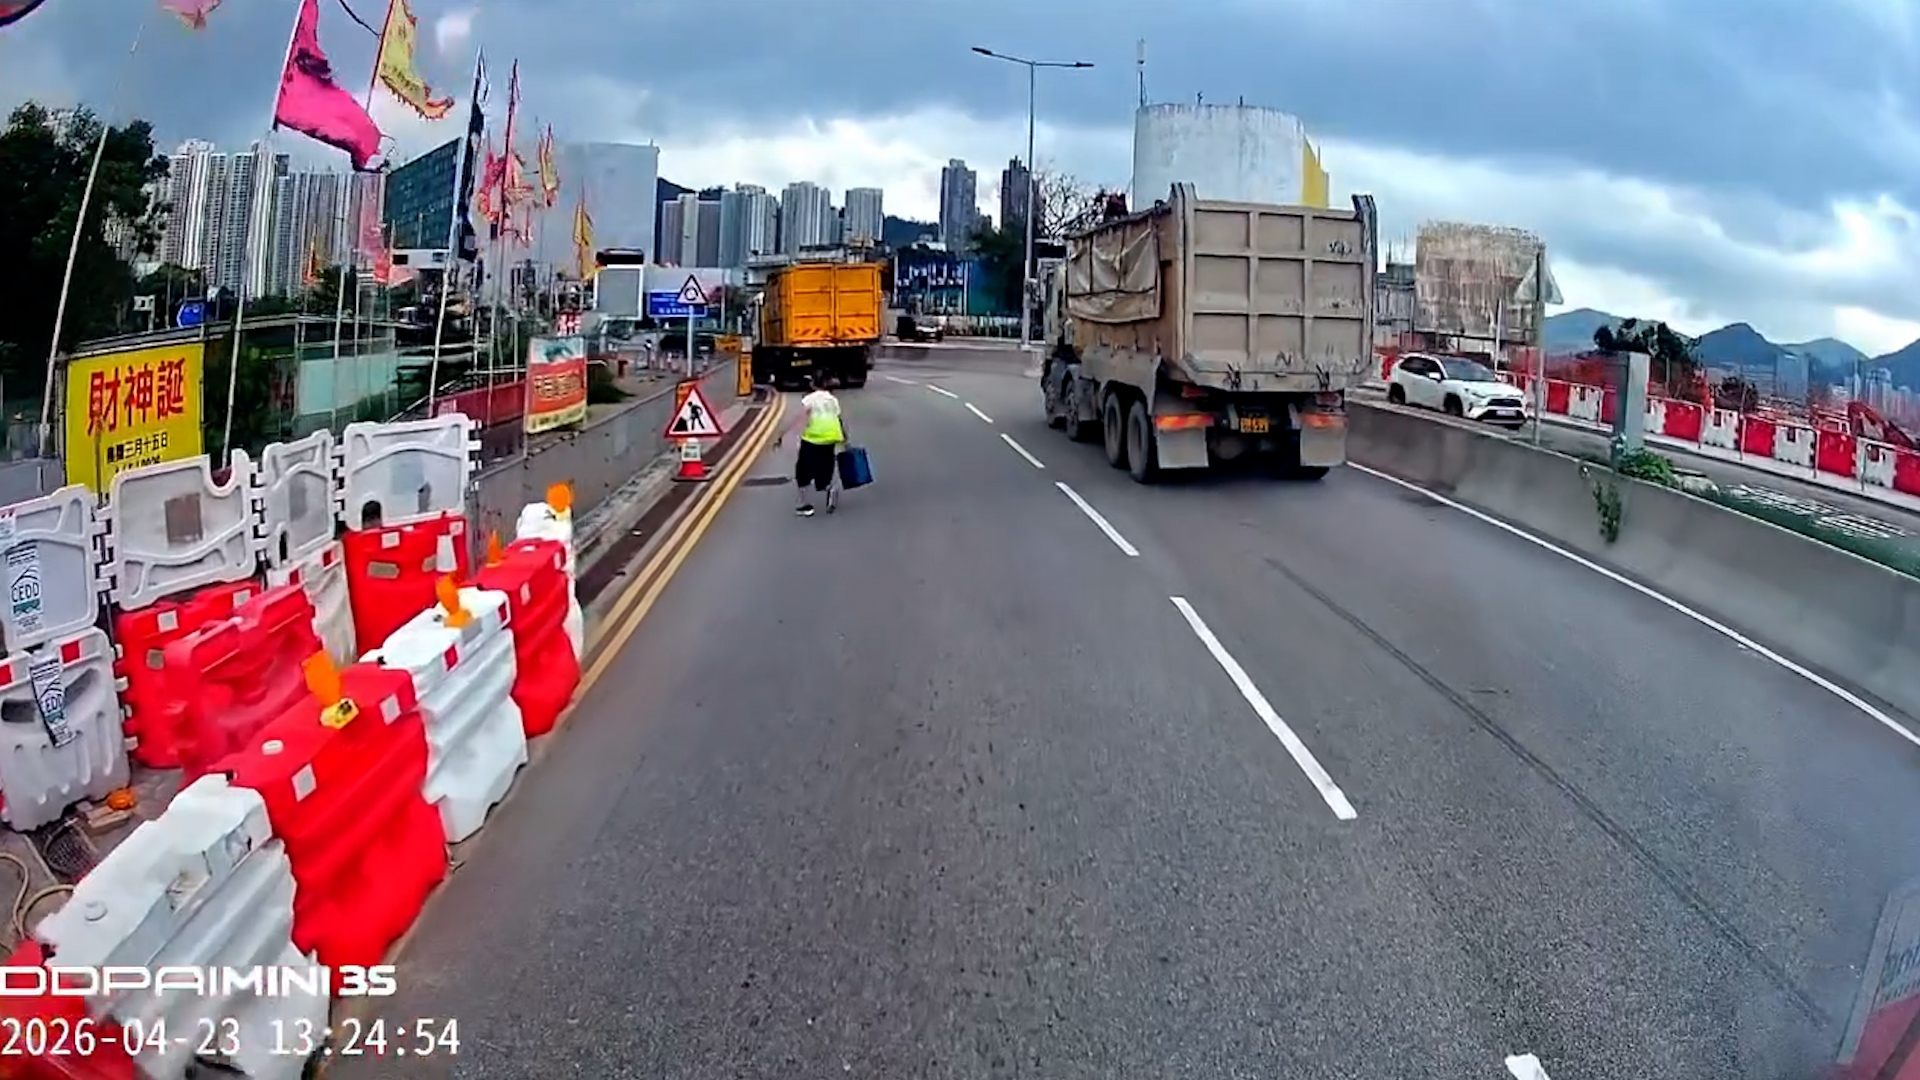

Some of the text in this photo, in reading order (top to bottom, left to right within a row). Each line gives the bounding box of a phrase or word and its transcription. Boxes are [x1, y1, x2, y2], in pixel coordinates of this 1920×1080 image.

[87, 358, 185, 436] 財神誕
[11, 582, 40, 603] CEDD
